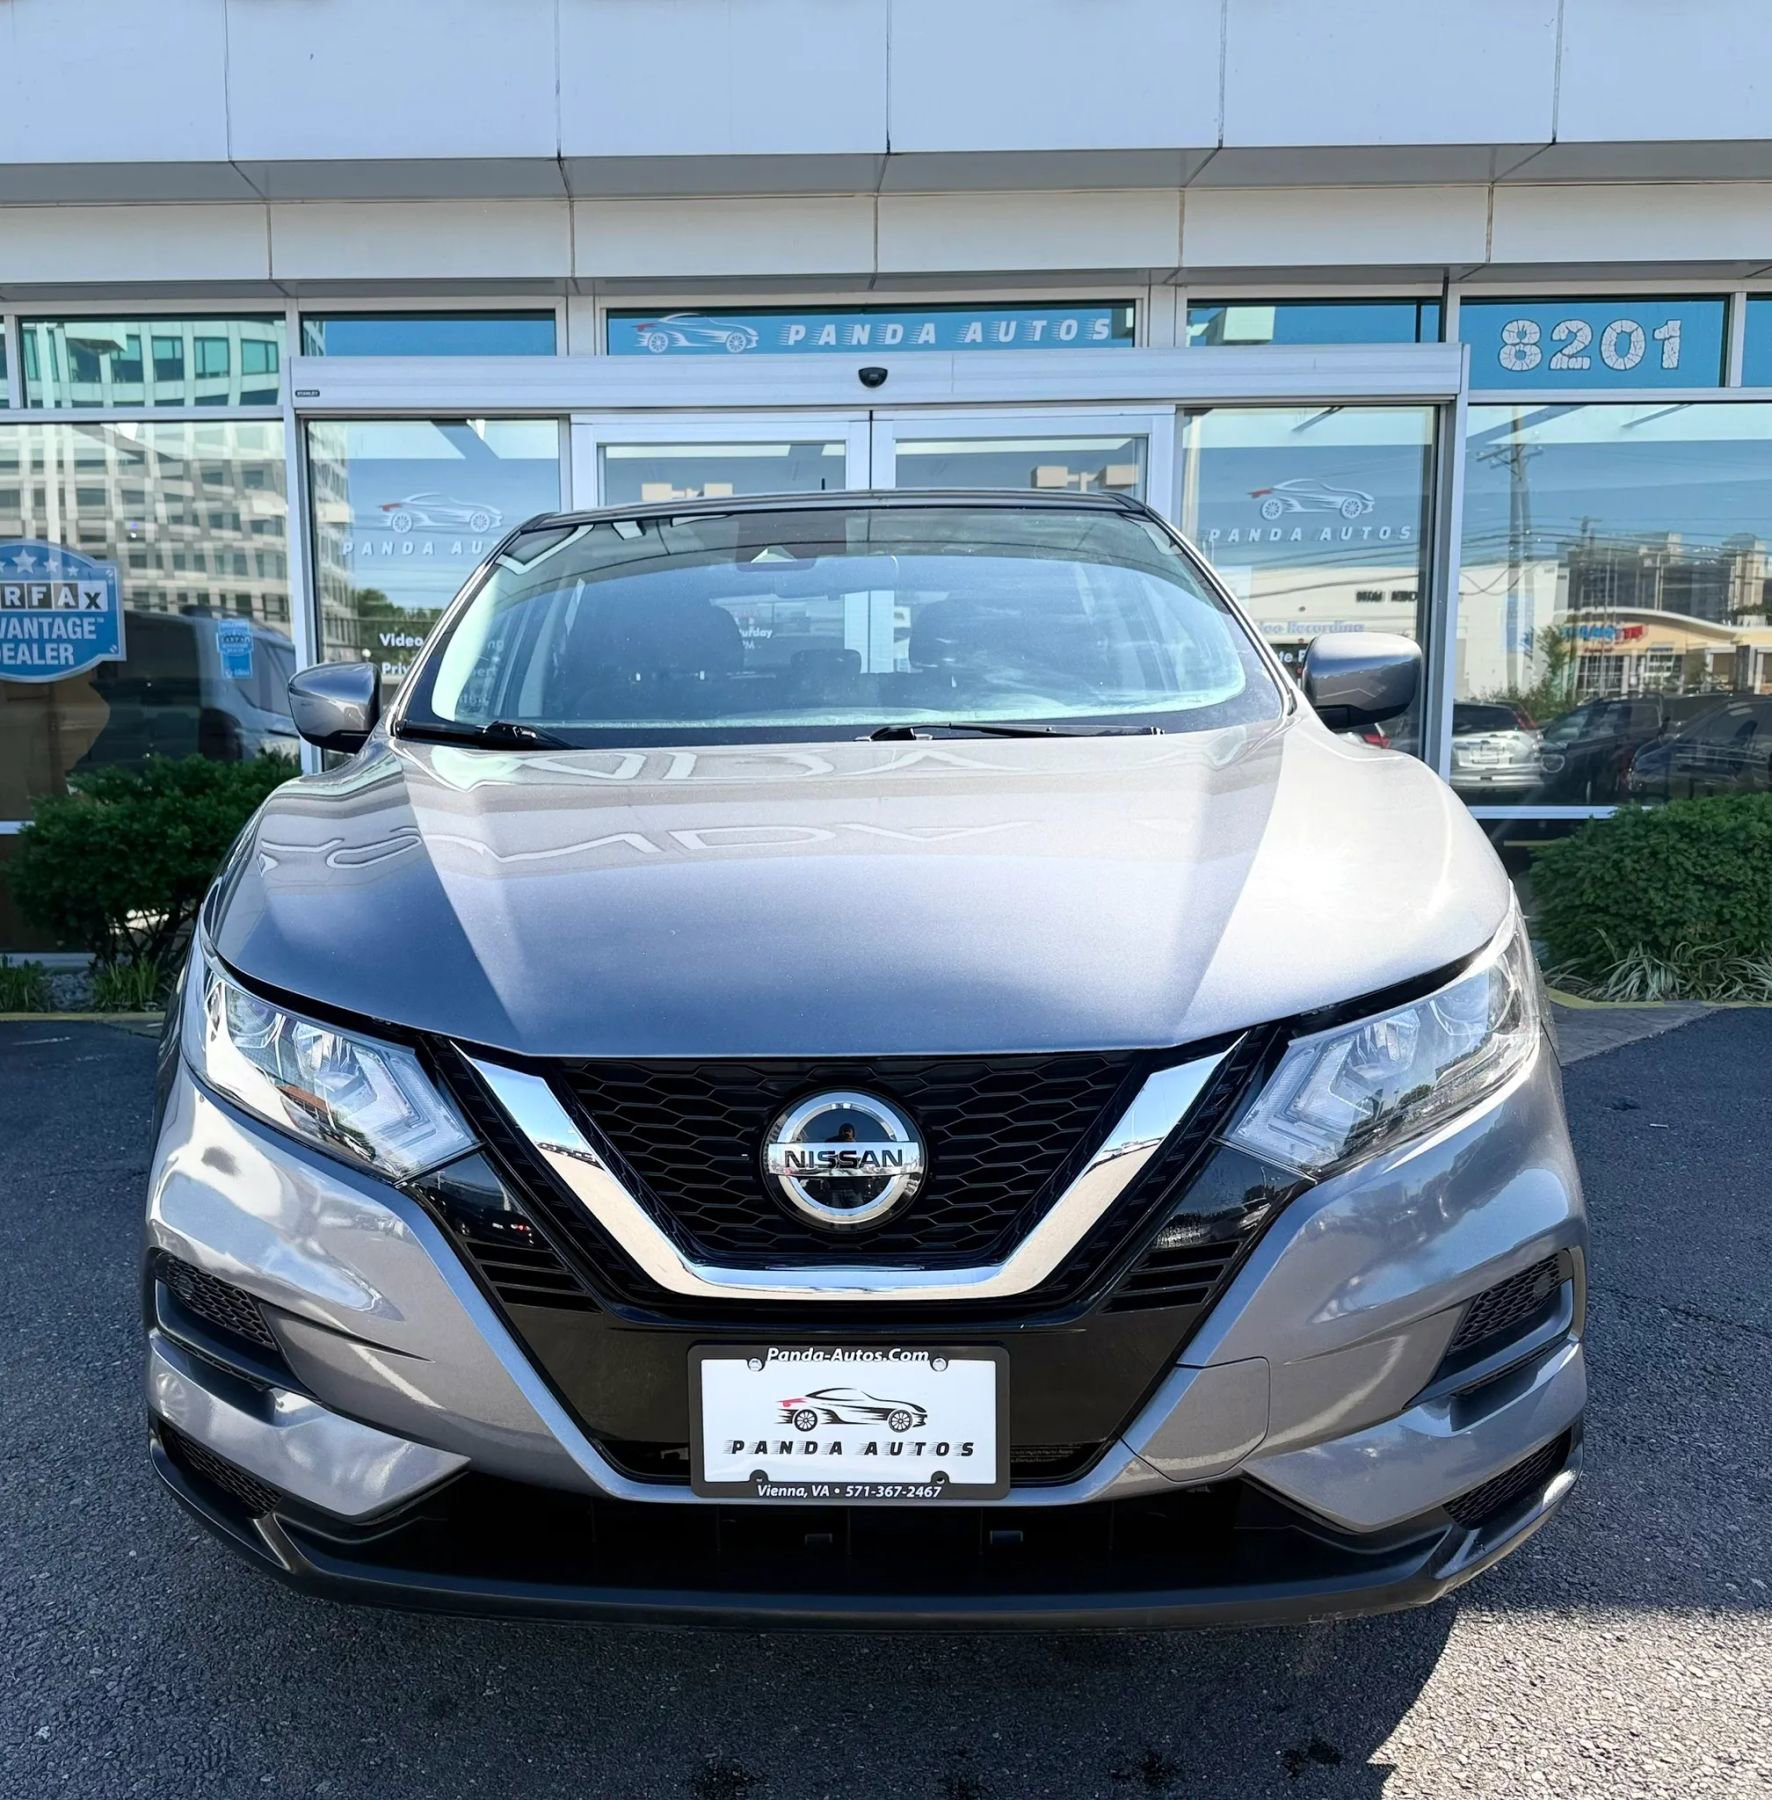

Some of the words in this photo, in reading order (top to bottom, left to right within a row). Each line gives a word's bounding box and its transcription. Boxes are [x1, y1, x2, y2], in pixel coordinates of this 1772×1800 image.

[778, 323, 936, 346] PANDA
[954, 318, 1110, 344] AUTOS
[1498, 319, 1681, 371] 8201
[1208, 527, 1302, 542] PANDA
[1320, 526, 1411, 541] AUTOS
[342, 541, 434, 556] PANDA
[451, 540, 500, 555] AU
[380, 632, 424, 647] Video
[0, 643, 74, 665] EALER
[784, 1149, 903, 1168] NISSAN
[767, 1347, 929, 1362] Panda-Autos.Com
[726, 1440, 843, 1455] PANDA
[858, 1441, 974, 1457] AUTOS
[757, 1484, 808, 1498] Vienna,
[811, 1485, 830, 1496] VA
[845, 1485, 942, 1498] 571-367-2467
